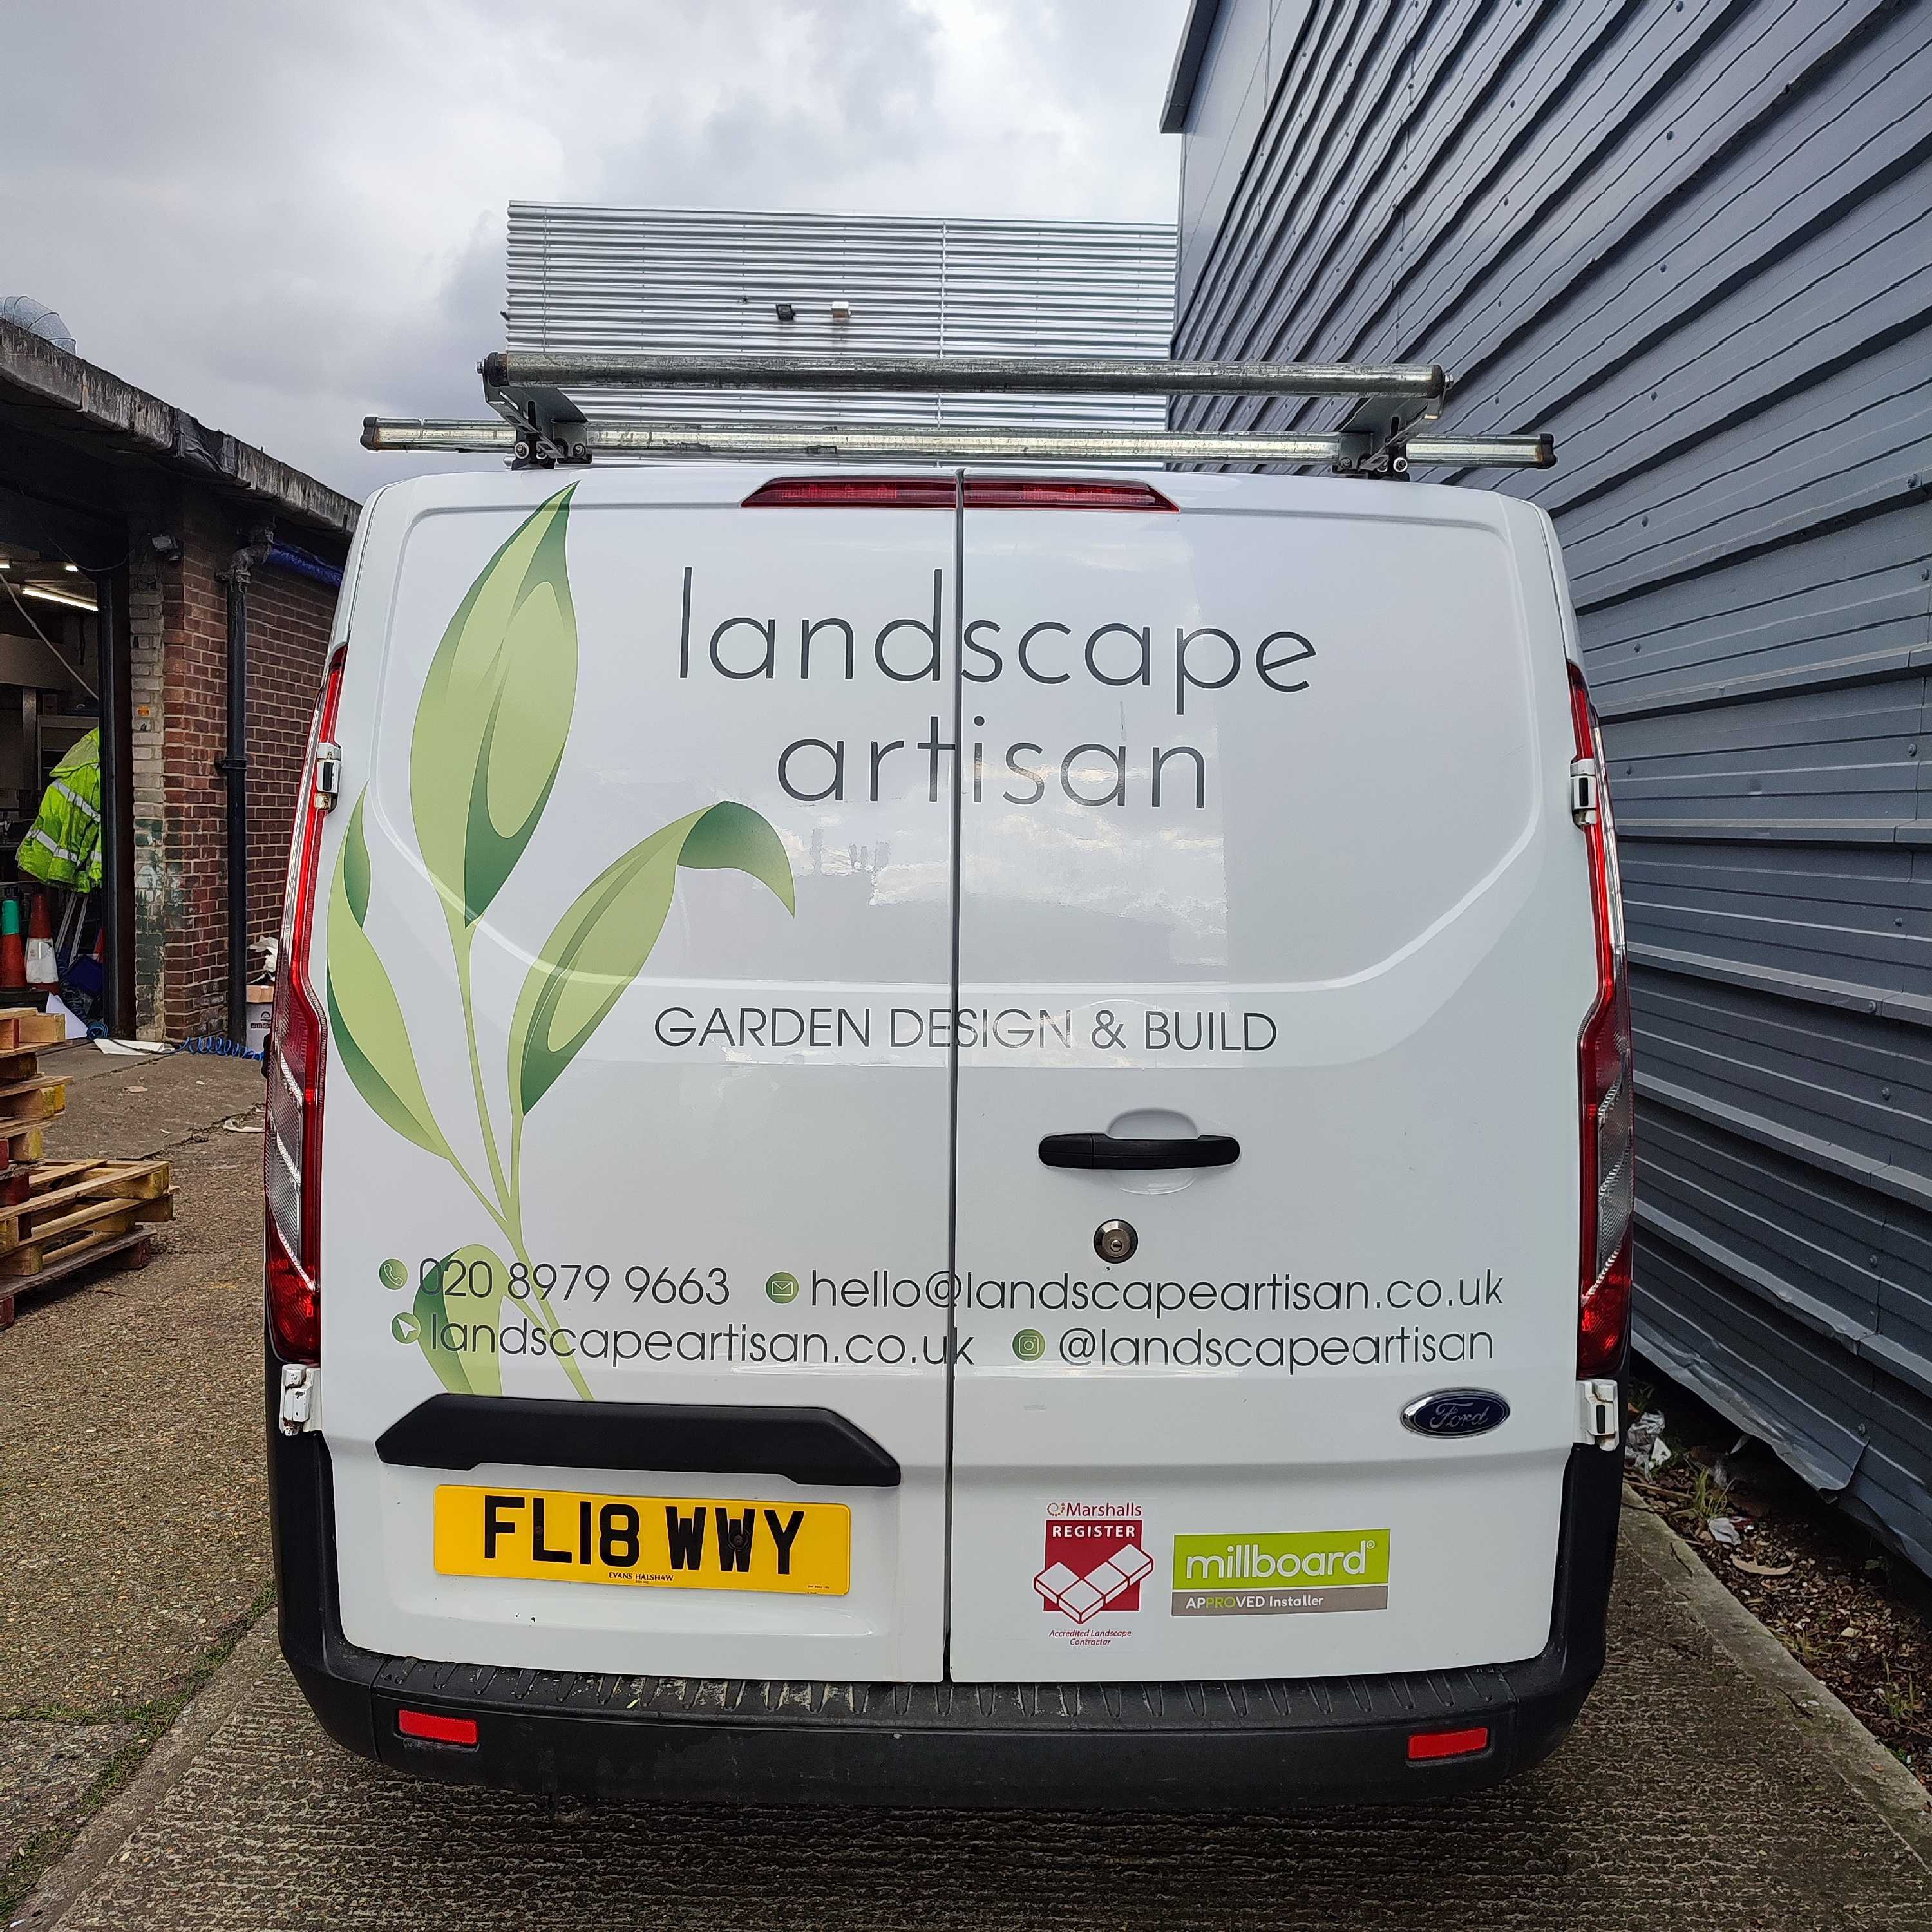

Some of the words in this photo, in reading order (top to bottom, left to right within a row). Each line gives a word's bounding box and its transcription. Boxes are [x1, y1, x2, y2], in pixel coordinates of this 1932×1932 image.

[679, 567, 1316, 715] landscape
[777, 715, 1205, 810] artisan
[654, 1007, 870, 1046] GARDEN
[891, 1009, 1071, 1048] DESIGN
[1091, 1009, 1126, 1050] &
[1146, 1011, 1277, 1051] BUILD
[419, 1258, 493, 1298] 020
[507, 1262, 611, 1302] 8979
[625, 1265, 730, 1305] 9663
[811, 1269, 1505, 1319] hello@landscapeartisan.co.uk
[431, 1313, 974, 1367] landscapeartisan.co.uk
[1059, 1326, 1493, 1375] @landscapeartisan
[1429, 1402, 1488, 1429] Ford
[1052, 1524, 1136, 1538] REGISTER
[1066, 1502, 1142, 1517] Marshalls
[484, 1495, 641, 1567] FL18
[665, 1506, 805, 1575] WWY
[609, 1571, 633, 1580] EVANS
[1186, 1595, 1266, 1609] APPROVED
[1269, 1595, 1324, 1608] Installer
[1049, 1629, 1090, 1638] Accredited
[1091, 1629, 1132, 1638] Landscape
